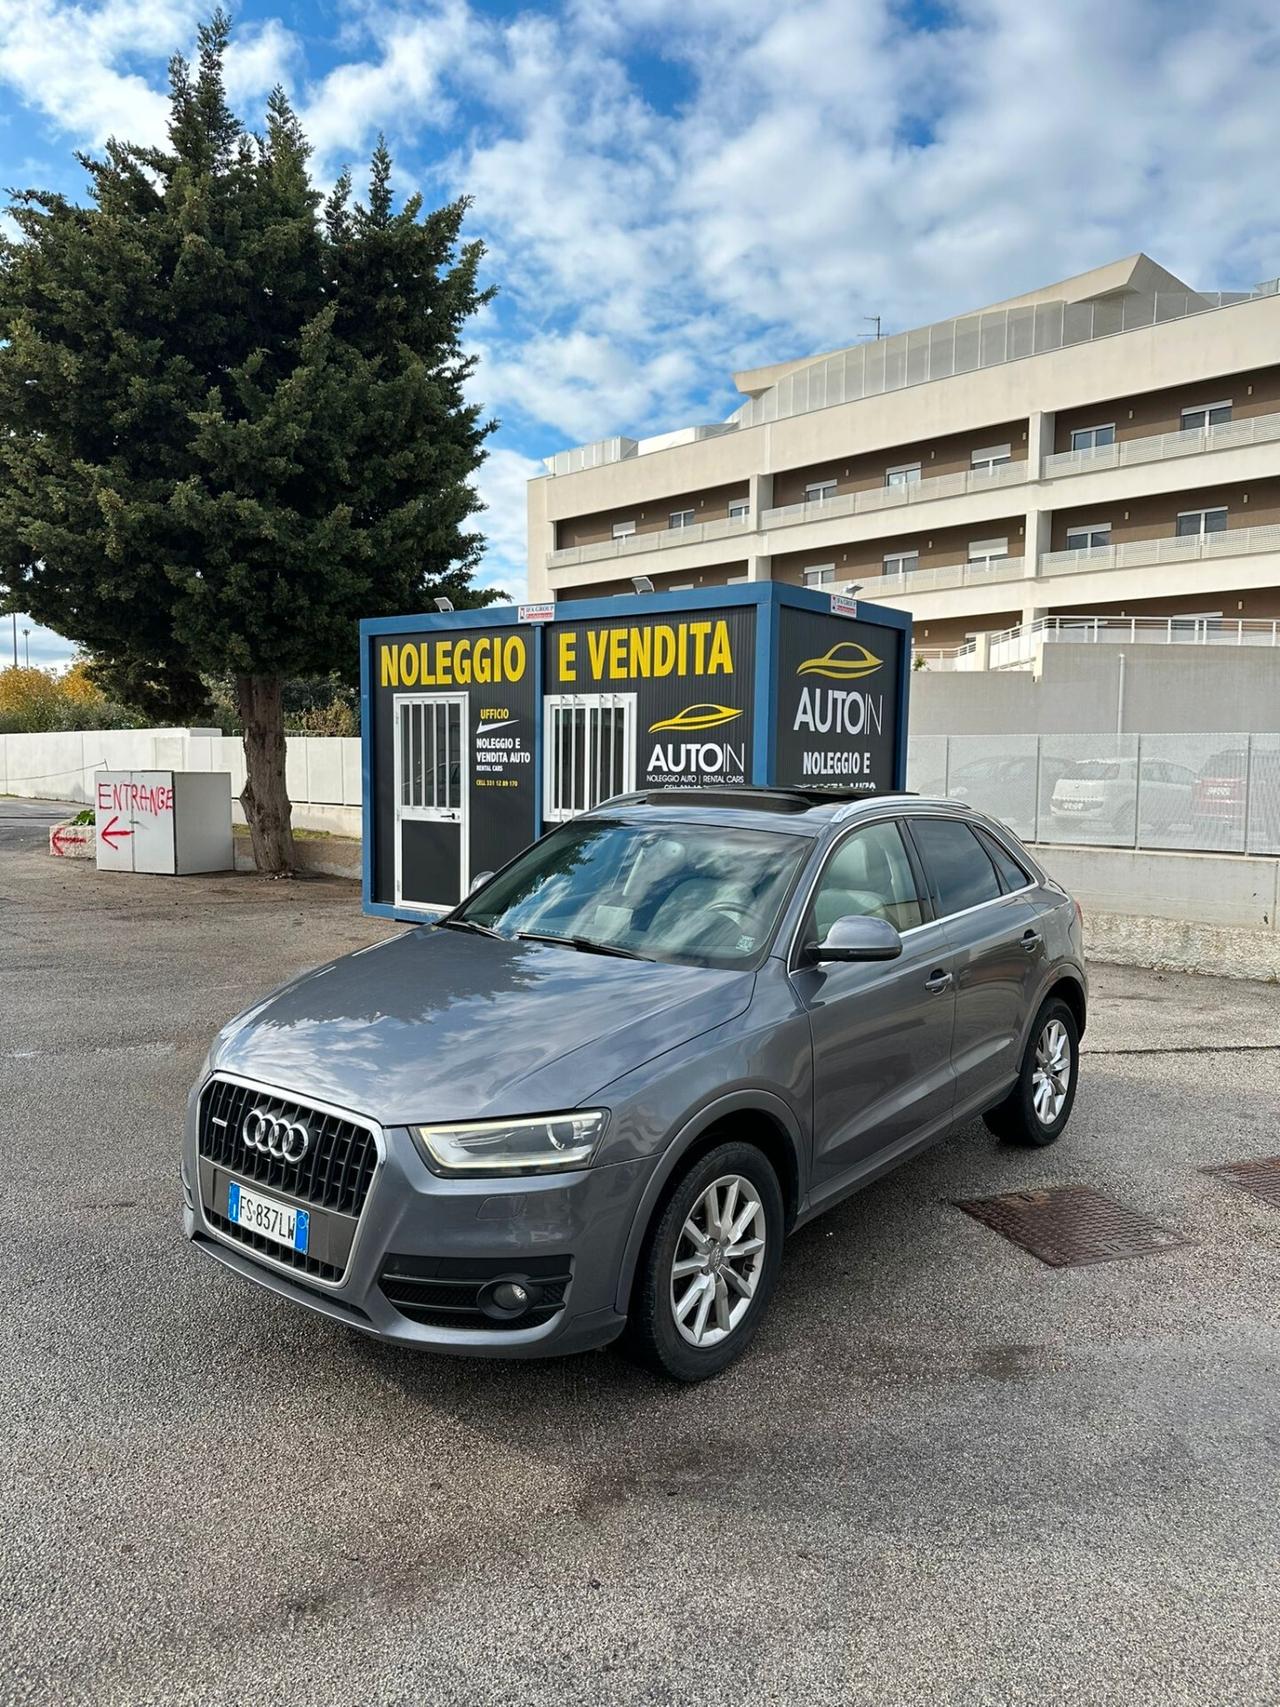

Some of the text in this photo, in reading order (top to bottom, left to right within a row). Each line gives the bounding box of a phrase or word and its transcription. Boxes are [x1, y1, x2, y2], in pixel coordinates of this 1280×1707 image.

[381, 620, 733, 687] NOLEGGIO E VENDITA
[480, 708, 509, 719] UFFICIO
[793, 687, 883, 735] AUTOIN
[476, 738, 520, 749] NOLEGGIO E
[476, 752, 531, 763] VENDITA AUTO
[647, 743, 745, 772] AUTOIN
[803, 751, 870, 774] NOLEGGIO E
[646, 774, 744, 783] NOLEGGIO AUTO RENTAL CARS
